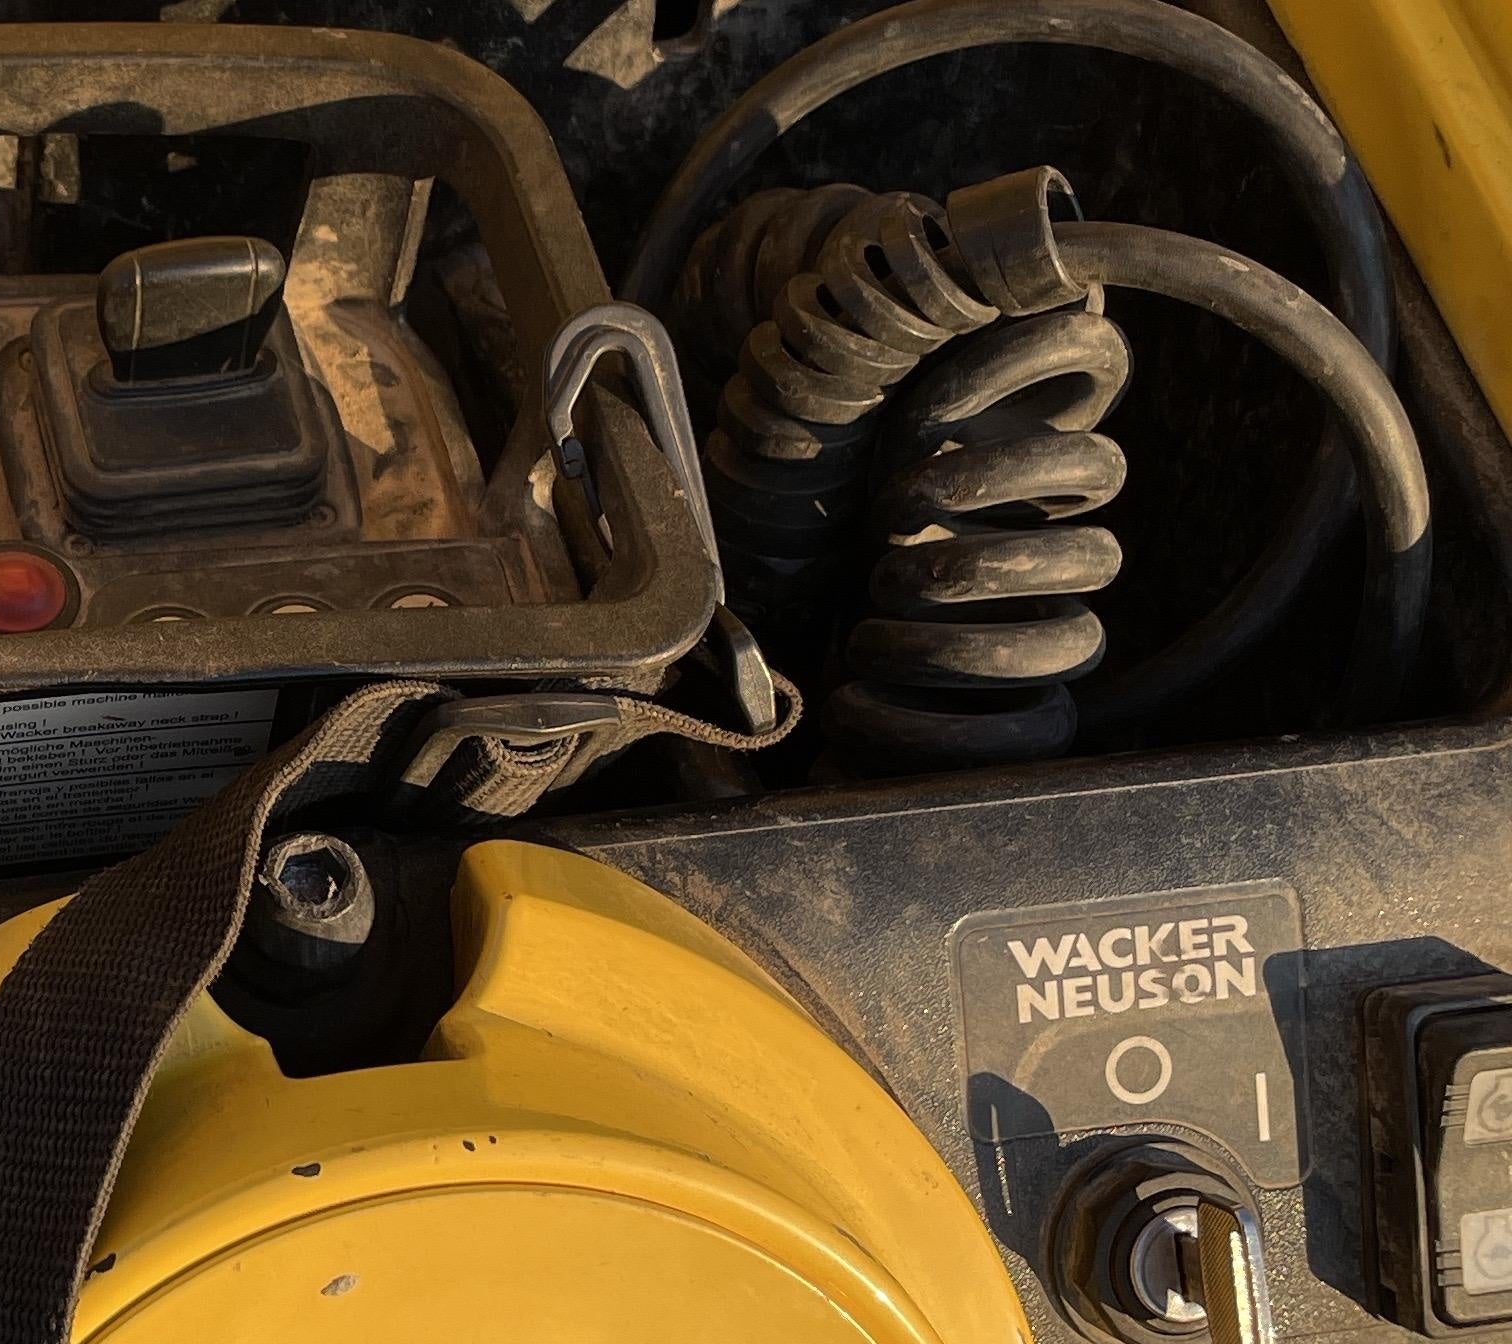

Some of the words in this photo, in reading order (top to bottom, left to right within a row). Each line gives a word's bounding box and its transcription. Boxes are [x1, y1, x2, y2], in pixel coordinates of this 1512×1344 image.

[3, 698, 66, 715] possible
[72, 691, 143, 706] machine
[1007, 914, 1255, 978] WACKER
[1016, 957, 1256, 1024] NEUSON
